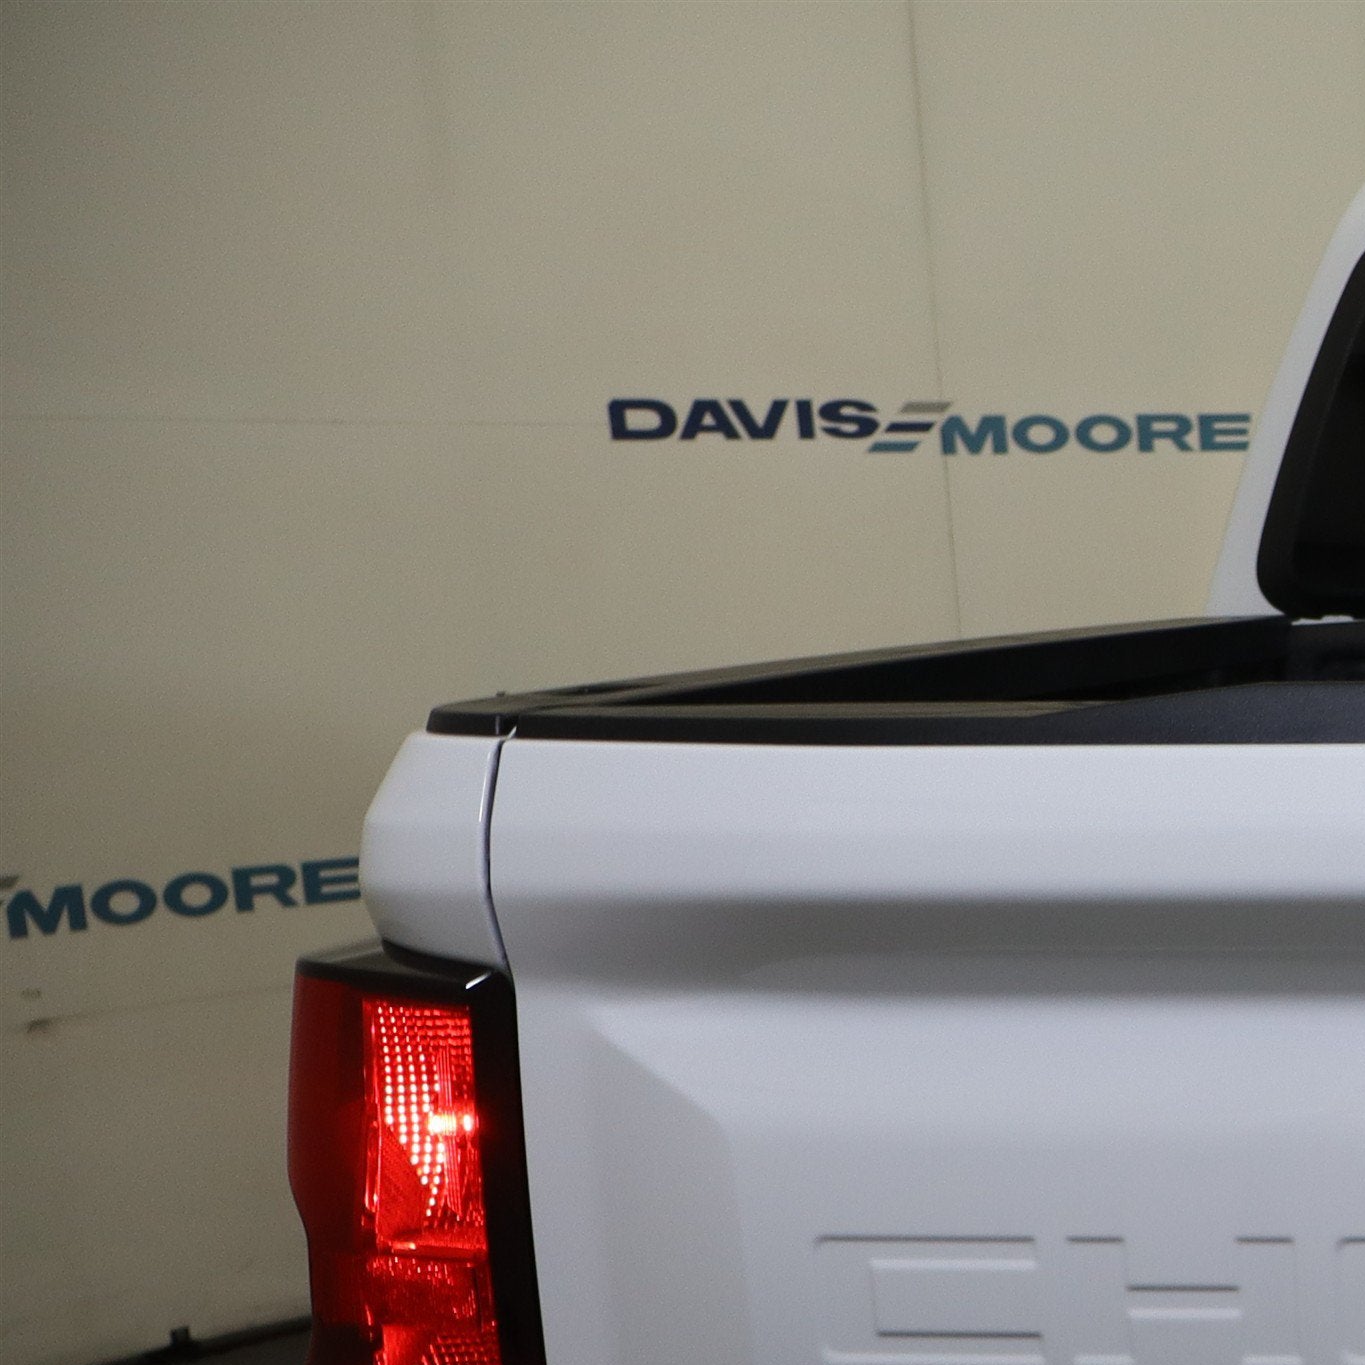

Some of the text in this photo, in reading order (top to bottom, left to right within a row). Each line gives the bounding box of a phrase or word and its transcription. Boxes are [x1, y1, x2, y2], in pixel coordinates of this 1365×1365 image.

[607, 398, 1252, 455] DAVIS MOORE
[6, 856, 361, 940] MOORE
